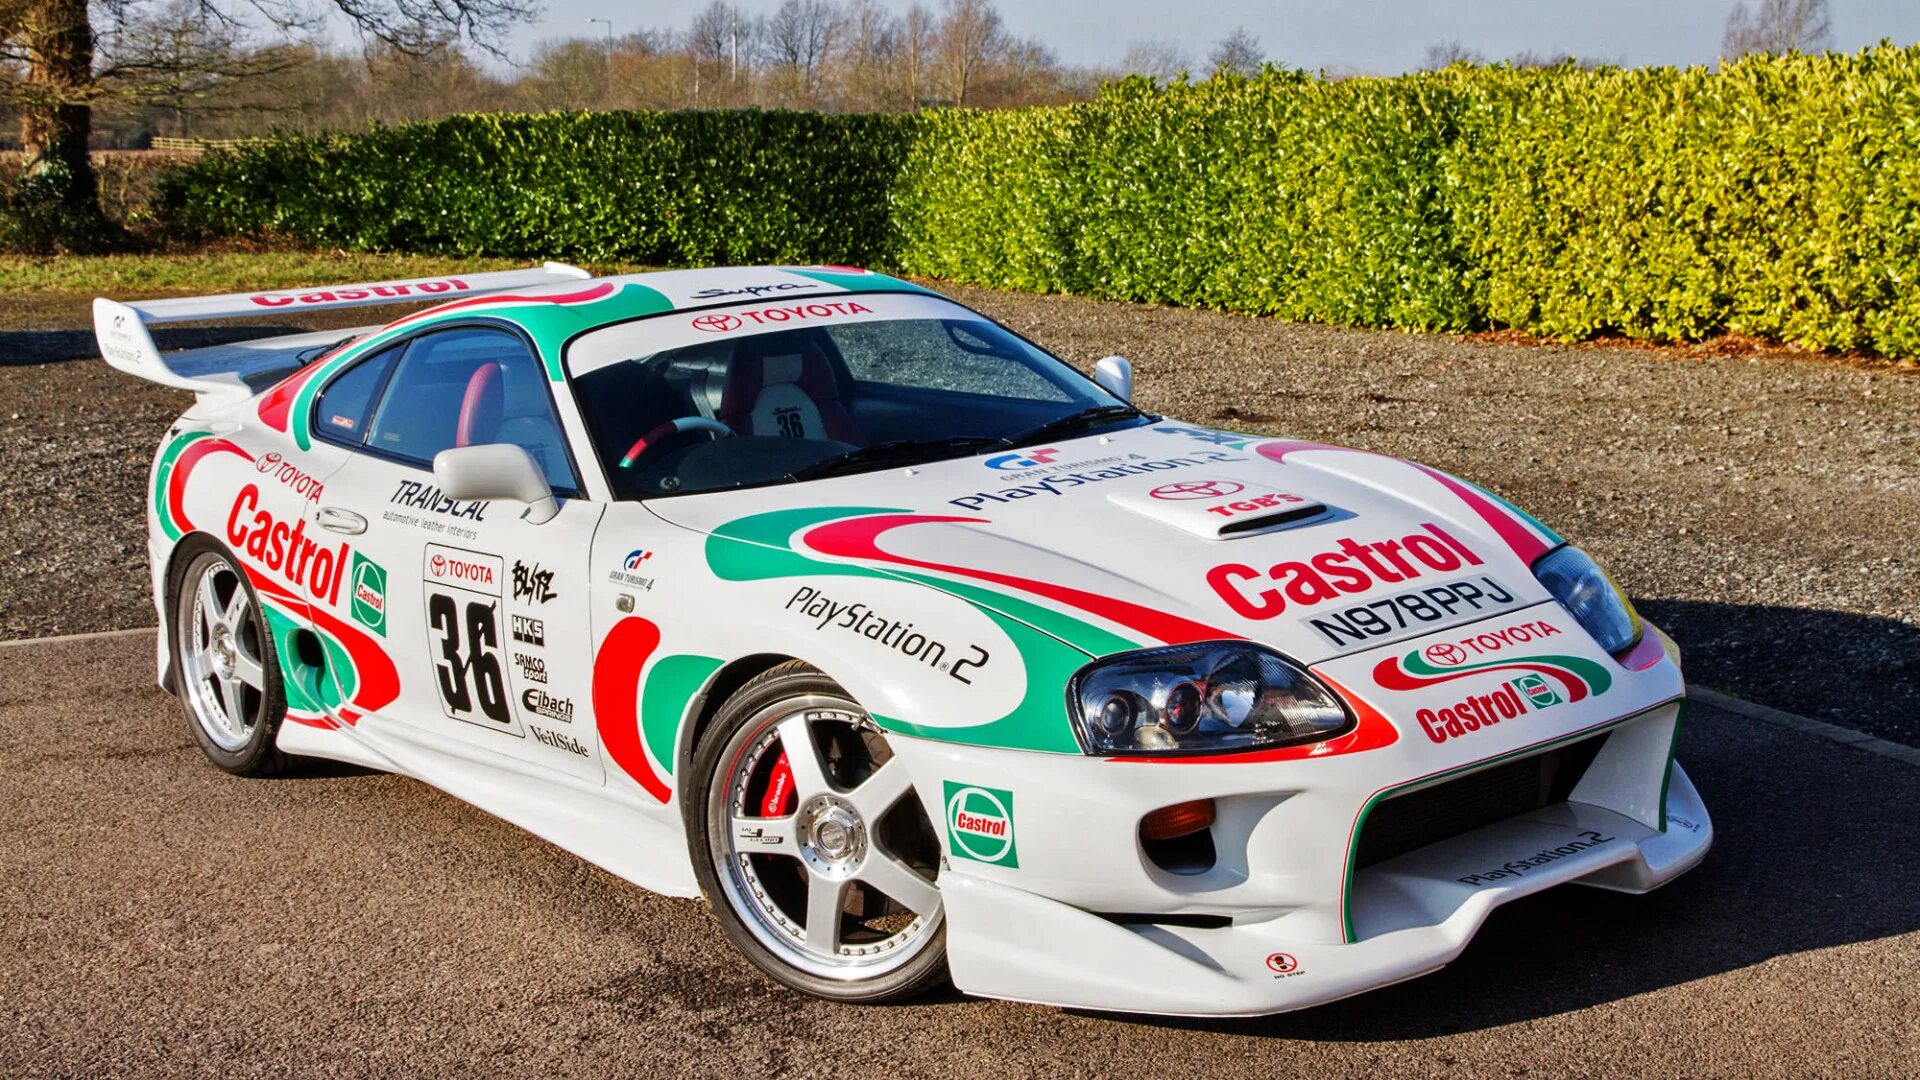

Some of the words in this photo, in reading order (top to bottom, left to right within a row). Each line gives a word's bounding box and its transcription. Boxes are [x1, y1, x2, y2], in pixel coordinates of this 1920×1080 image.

[250, 279, 470, 307] Castrol
[690, 282, 818, 299] Supra
[742, 302, 874, 325] TOYOTA
[776, 412, 805, 438] 36
[1000, 469, 1049, 482] GRAN
[1050, 456, 1122, 474] TURISMO
[1127, 453, 1147, 461] 4
[274, 462, 325, 504] TOYOTA
[949, 458, 1206, 511] PlayStation
[390, 479, 490, 522] TRANSCAL
[382, 510, 420, 528] automotive
[420, 517, 446, 533] leather
[446, 522, 478, 541] interiors
[227, 483, 350, 607] Castrol
[448, 560, 493, 585] TOYOTA
[646, 578, 655, 592] 4
[1206, 522, 1485, 621] Castrol
[356, 581, 383, 609] Castrol
[1310, 576, 1514, 647] N978PPJ
[513, 615, 544, 640] HKS
[785, 586, 946, 667] PlayStation
[949, 644, 990, 685] 2
[1460, 620, 1562, 654] TOYOTA
[429, 593, 511, 724] 36
[515, 653, 545, 672] SAMCO
[524, 668, 547, 684] sport
[1527, 683, 1548, 697] Castrol
[522, 688, 573, 715] Eibach
[1415, 682, 1528, 744] Castrol
[529, 724, 589, 757] VeilSide
[772, 772, 786, 804] brembo
[957, 811, 1006, 837] Castrol
[1457, 840, 1592, 886] PlayStation
[1577, 831, 1616, 843] 2
